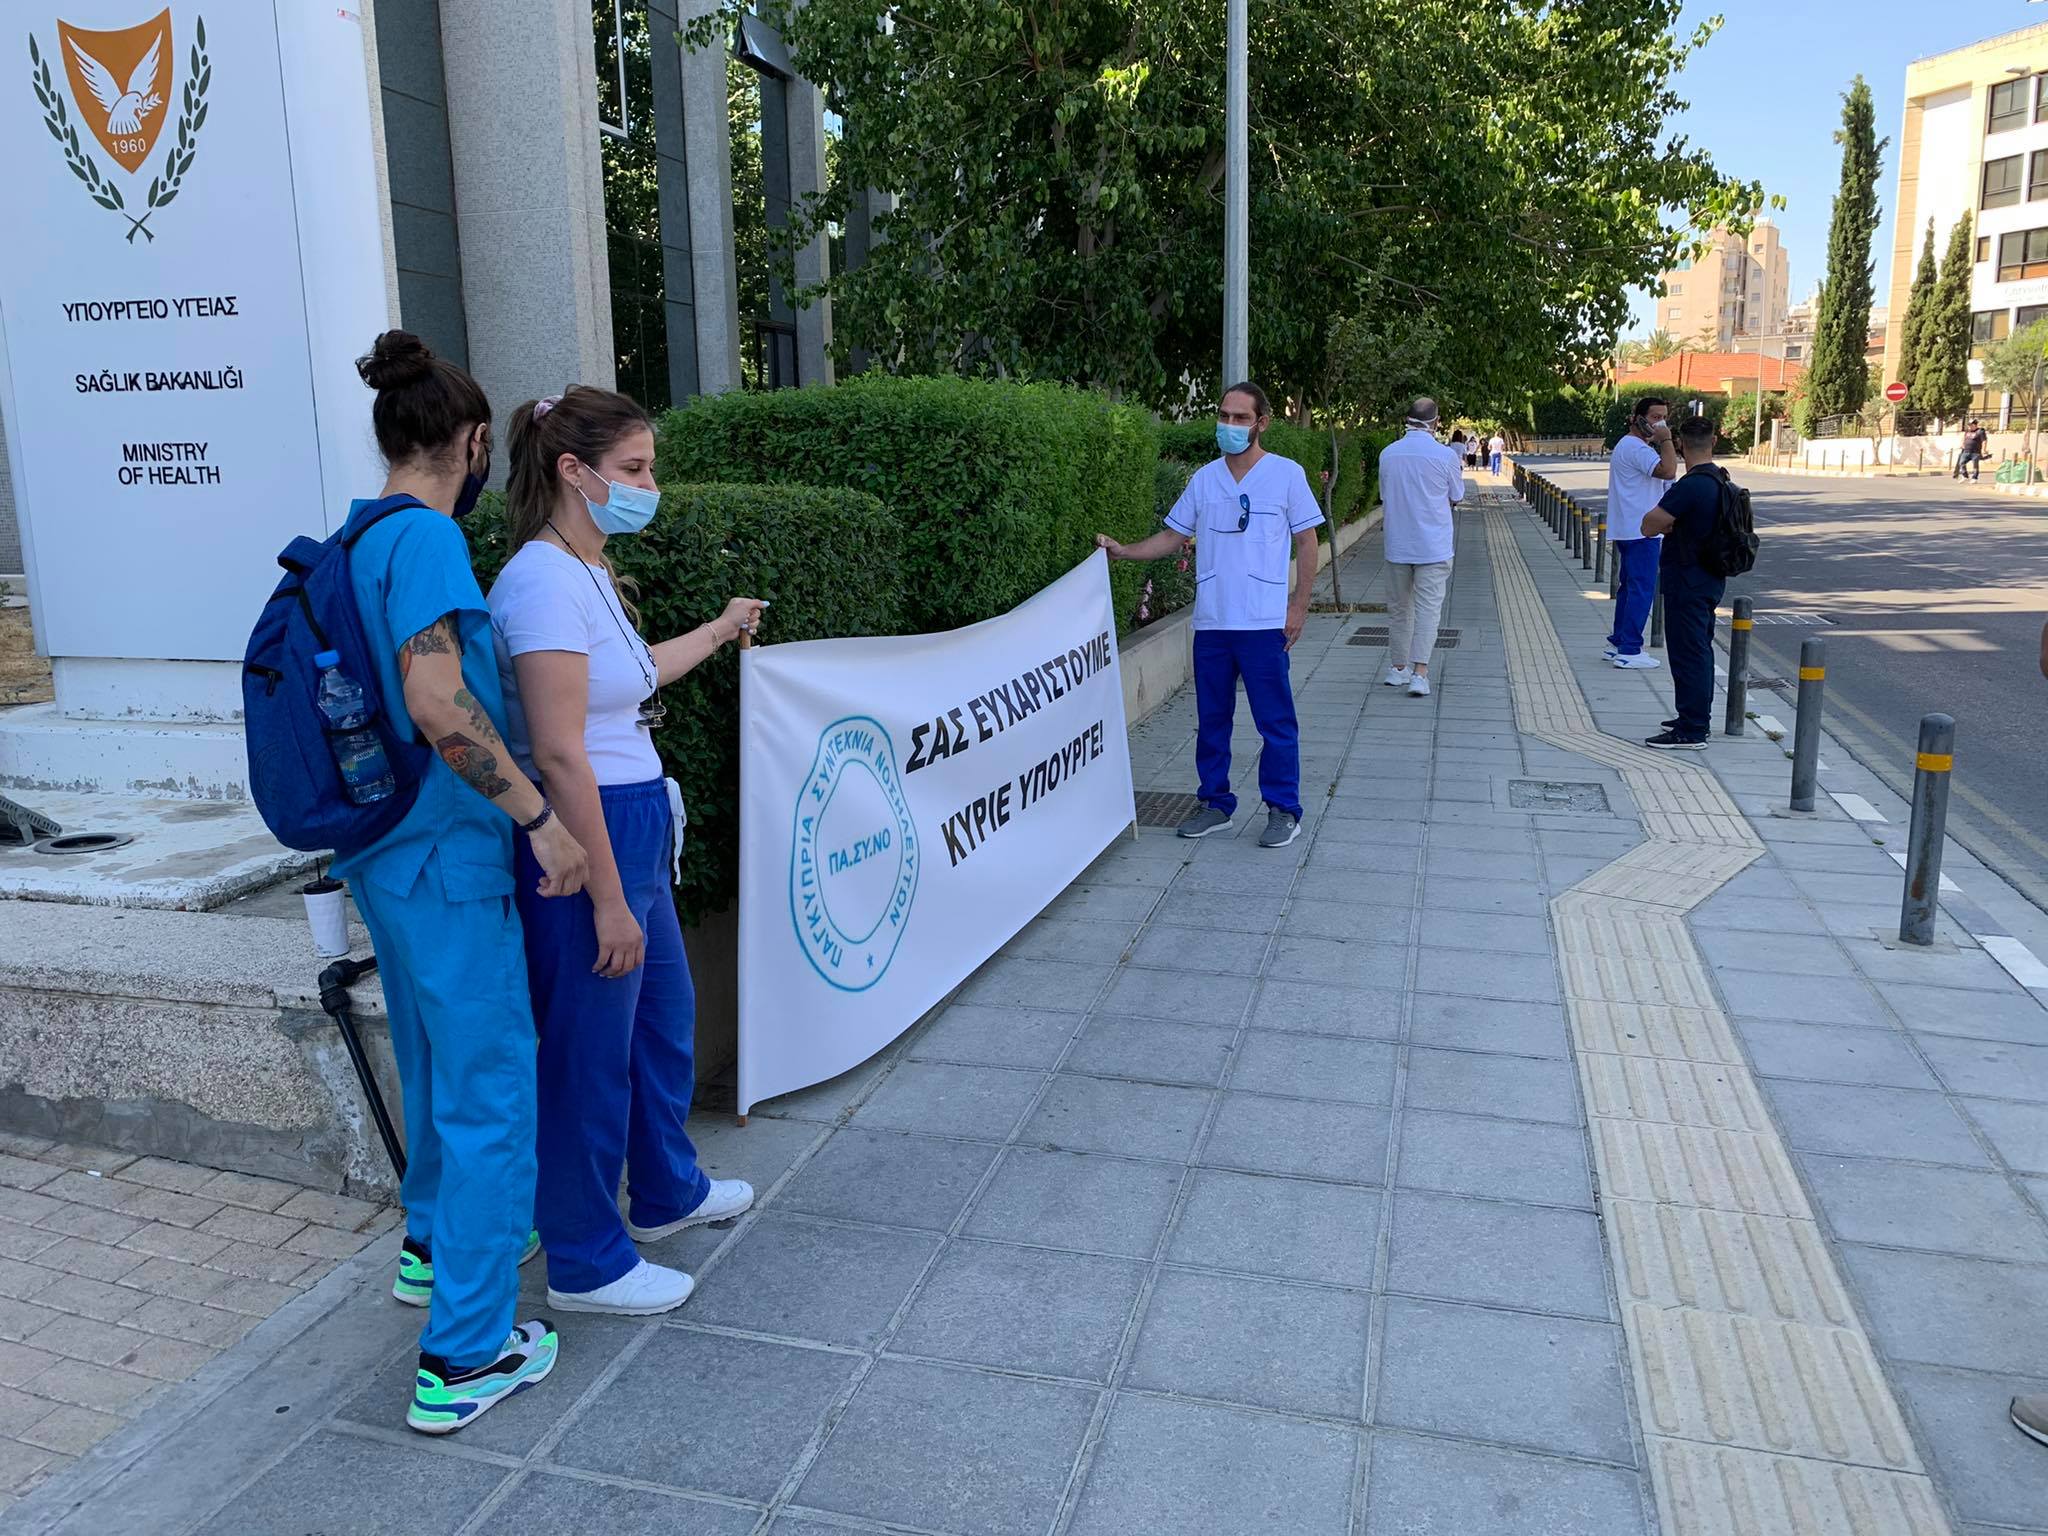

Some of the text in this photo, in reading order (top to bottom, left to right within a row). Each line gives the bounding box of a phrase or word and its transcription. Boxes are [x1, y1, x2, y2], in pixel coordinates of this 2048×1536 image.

[112, 138, 146, 154] 1960
[63, 297, 239, 322] ΥΠΟΥΡΓΕΙΟ ΥΓΕΙΑΣ
[75, 365, 243, 393] SAĞLIK BAKANLIĞI
[123, 443, 208, 462] MINISTRY
[118, 466, 220, 485] OF HEALTH
[905, 631, 1112, 774] ΣΑΣ ΕΥΧΑΡΙΣΤΟΥΜΕ
[811, 730, 875, 802] ΣΥΝΤΕΧΝΙΑ
[940, 719, 1104, 868] ΚΥΡΙΕ ΥΠΟΥΡΓΕ!
[828, 828, 891, 876] ΠΑ.ΣΥ.ΝΟ
[801, 816, 844, 968] ΠΑΓΚΥΠΡΙΑ
